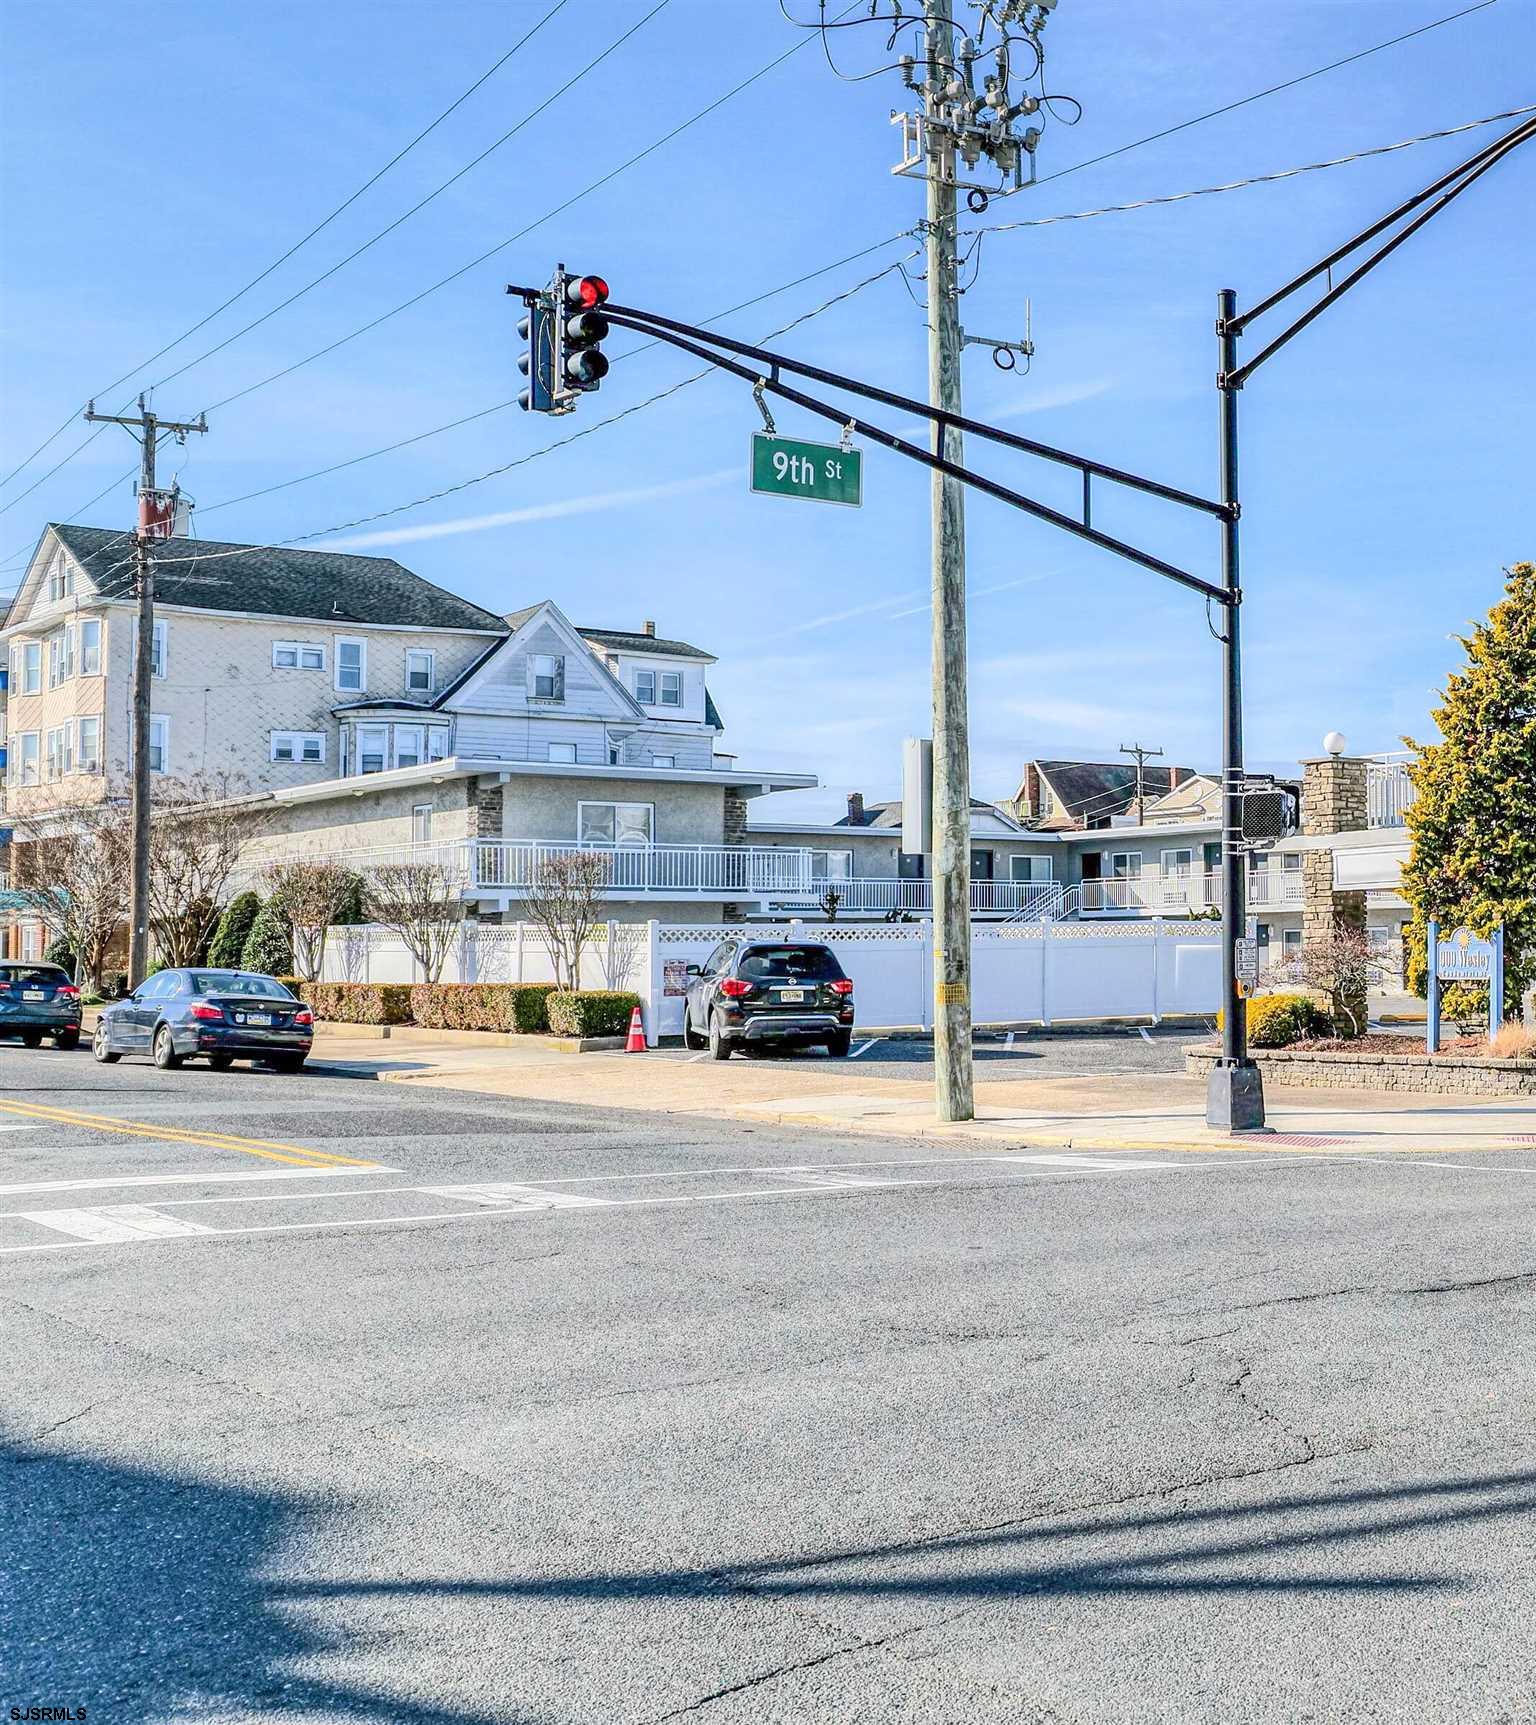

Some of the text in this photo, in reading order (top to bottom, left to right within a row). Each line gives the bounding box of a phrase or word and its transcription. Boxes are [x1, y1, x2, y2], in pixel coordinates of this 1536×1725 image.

[772, 451, 842, 485] 9th St
[1459, 950, 1491, 971] Wesley
